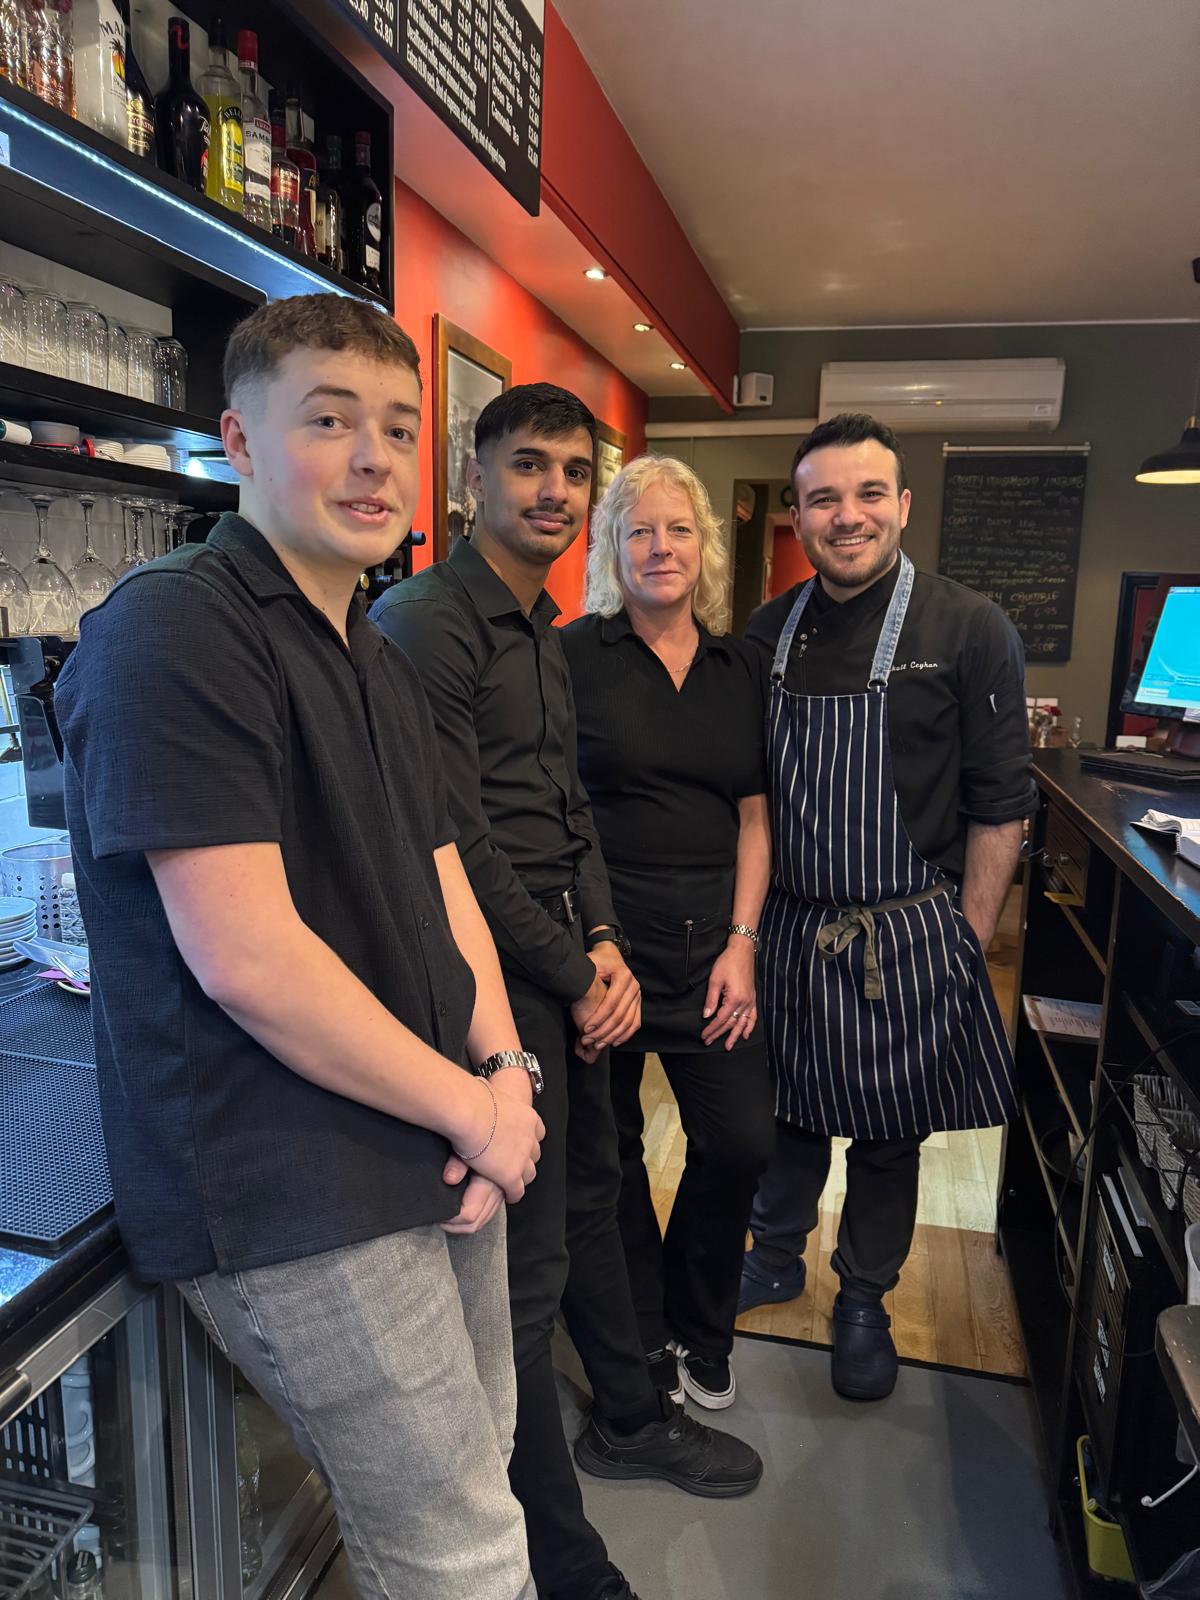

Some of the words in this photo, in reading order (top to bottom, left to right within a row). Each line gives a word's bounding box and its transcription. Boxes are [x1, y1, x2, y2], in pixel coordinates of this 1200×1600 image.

[374, 12, 394, 48] £3.80
[492, 32, 502, 58] Earl
[502, 46, 513, 77] Grey
[513, 61, 521, 85] Tea
[491, 77, 505, 108] Green
[505, 94, 513, 118] Tea
[492, 54, 516, 100] Peppermint
[515, 86, 524, 110] Tea
[512, 124, 520, 147] Tea
